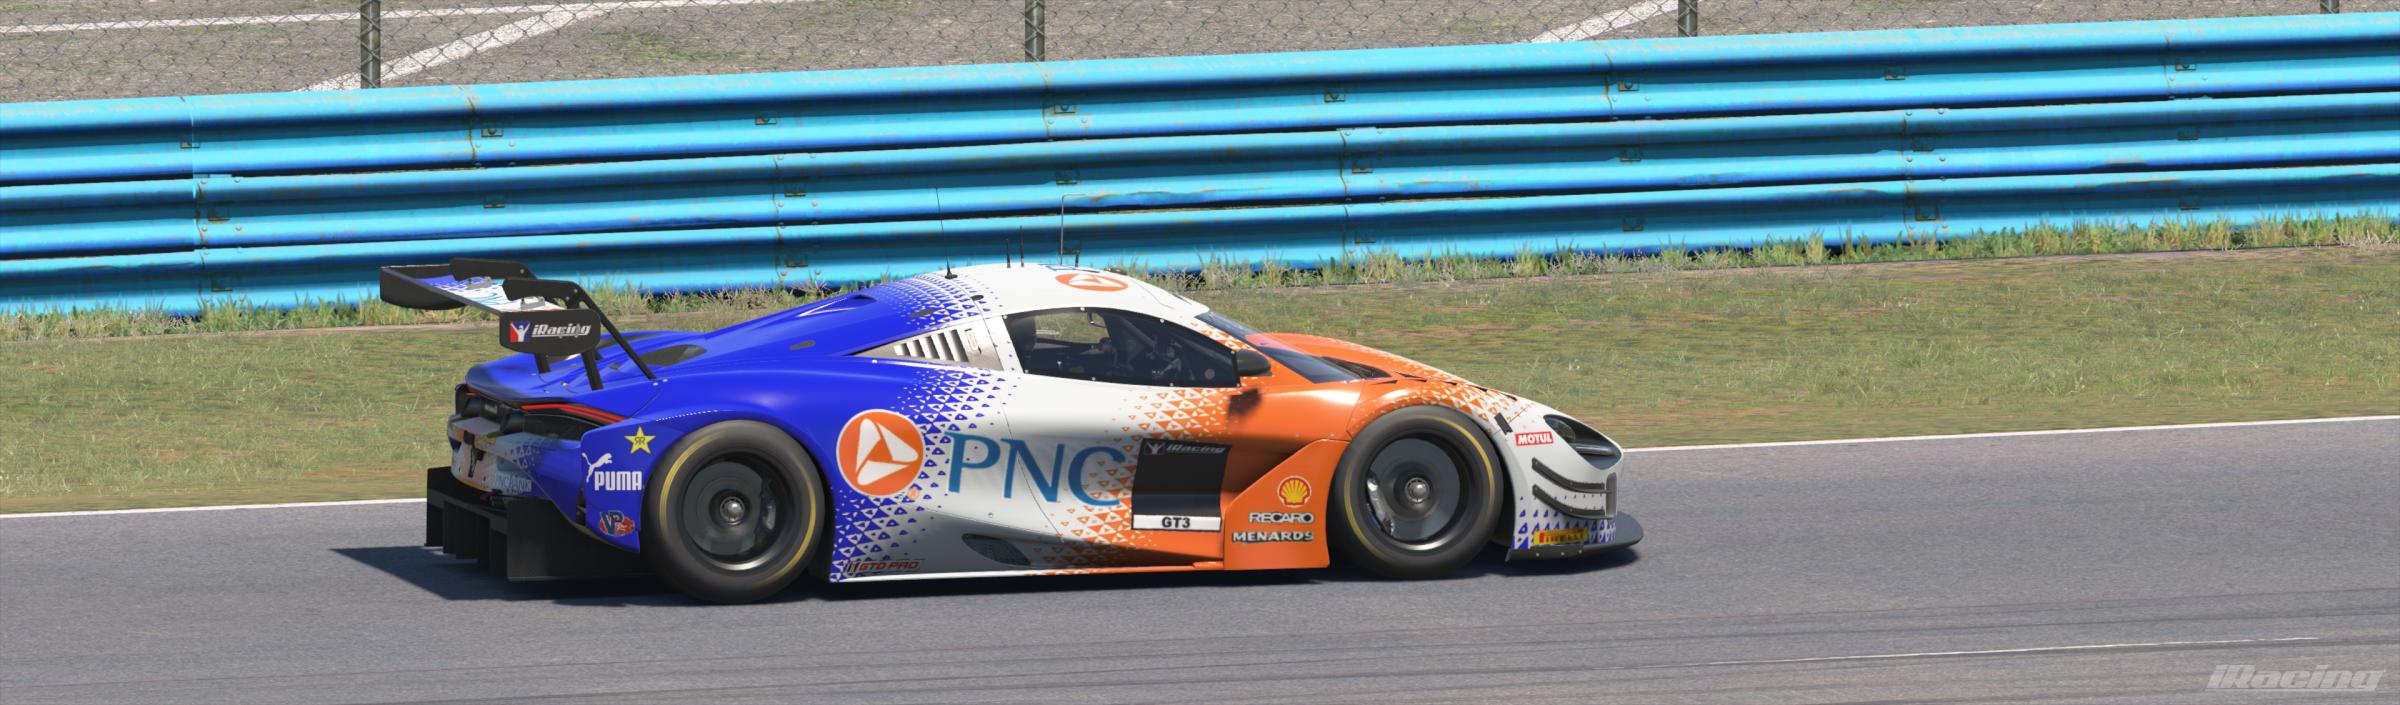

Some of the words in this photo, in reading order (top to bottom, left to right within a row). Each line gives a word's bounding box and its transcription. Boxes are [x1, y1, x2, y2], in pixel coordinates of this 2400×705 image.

[532, 323, 591, 338] iRacing
[1518, 433, 1552, 444] MOTUL
[1166, 444, 1225, 454] iRacing
[944, 431, 1126, 506] PNC
[594, 471, 642, 491] PUMA
[1162, 517, 1190, 528] GT3
[1249, 512, 1314, 523] RECARO
[1232, 531, 1314, 542] MENARDS
